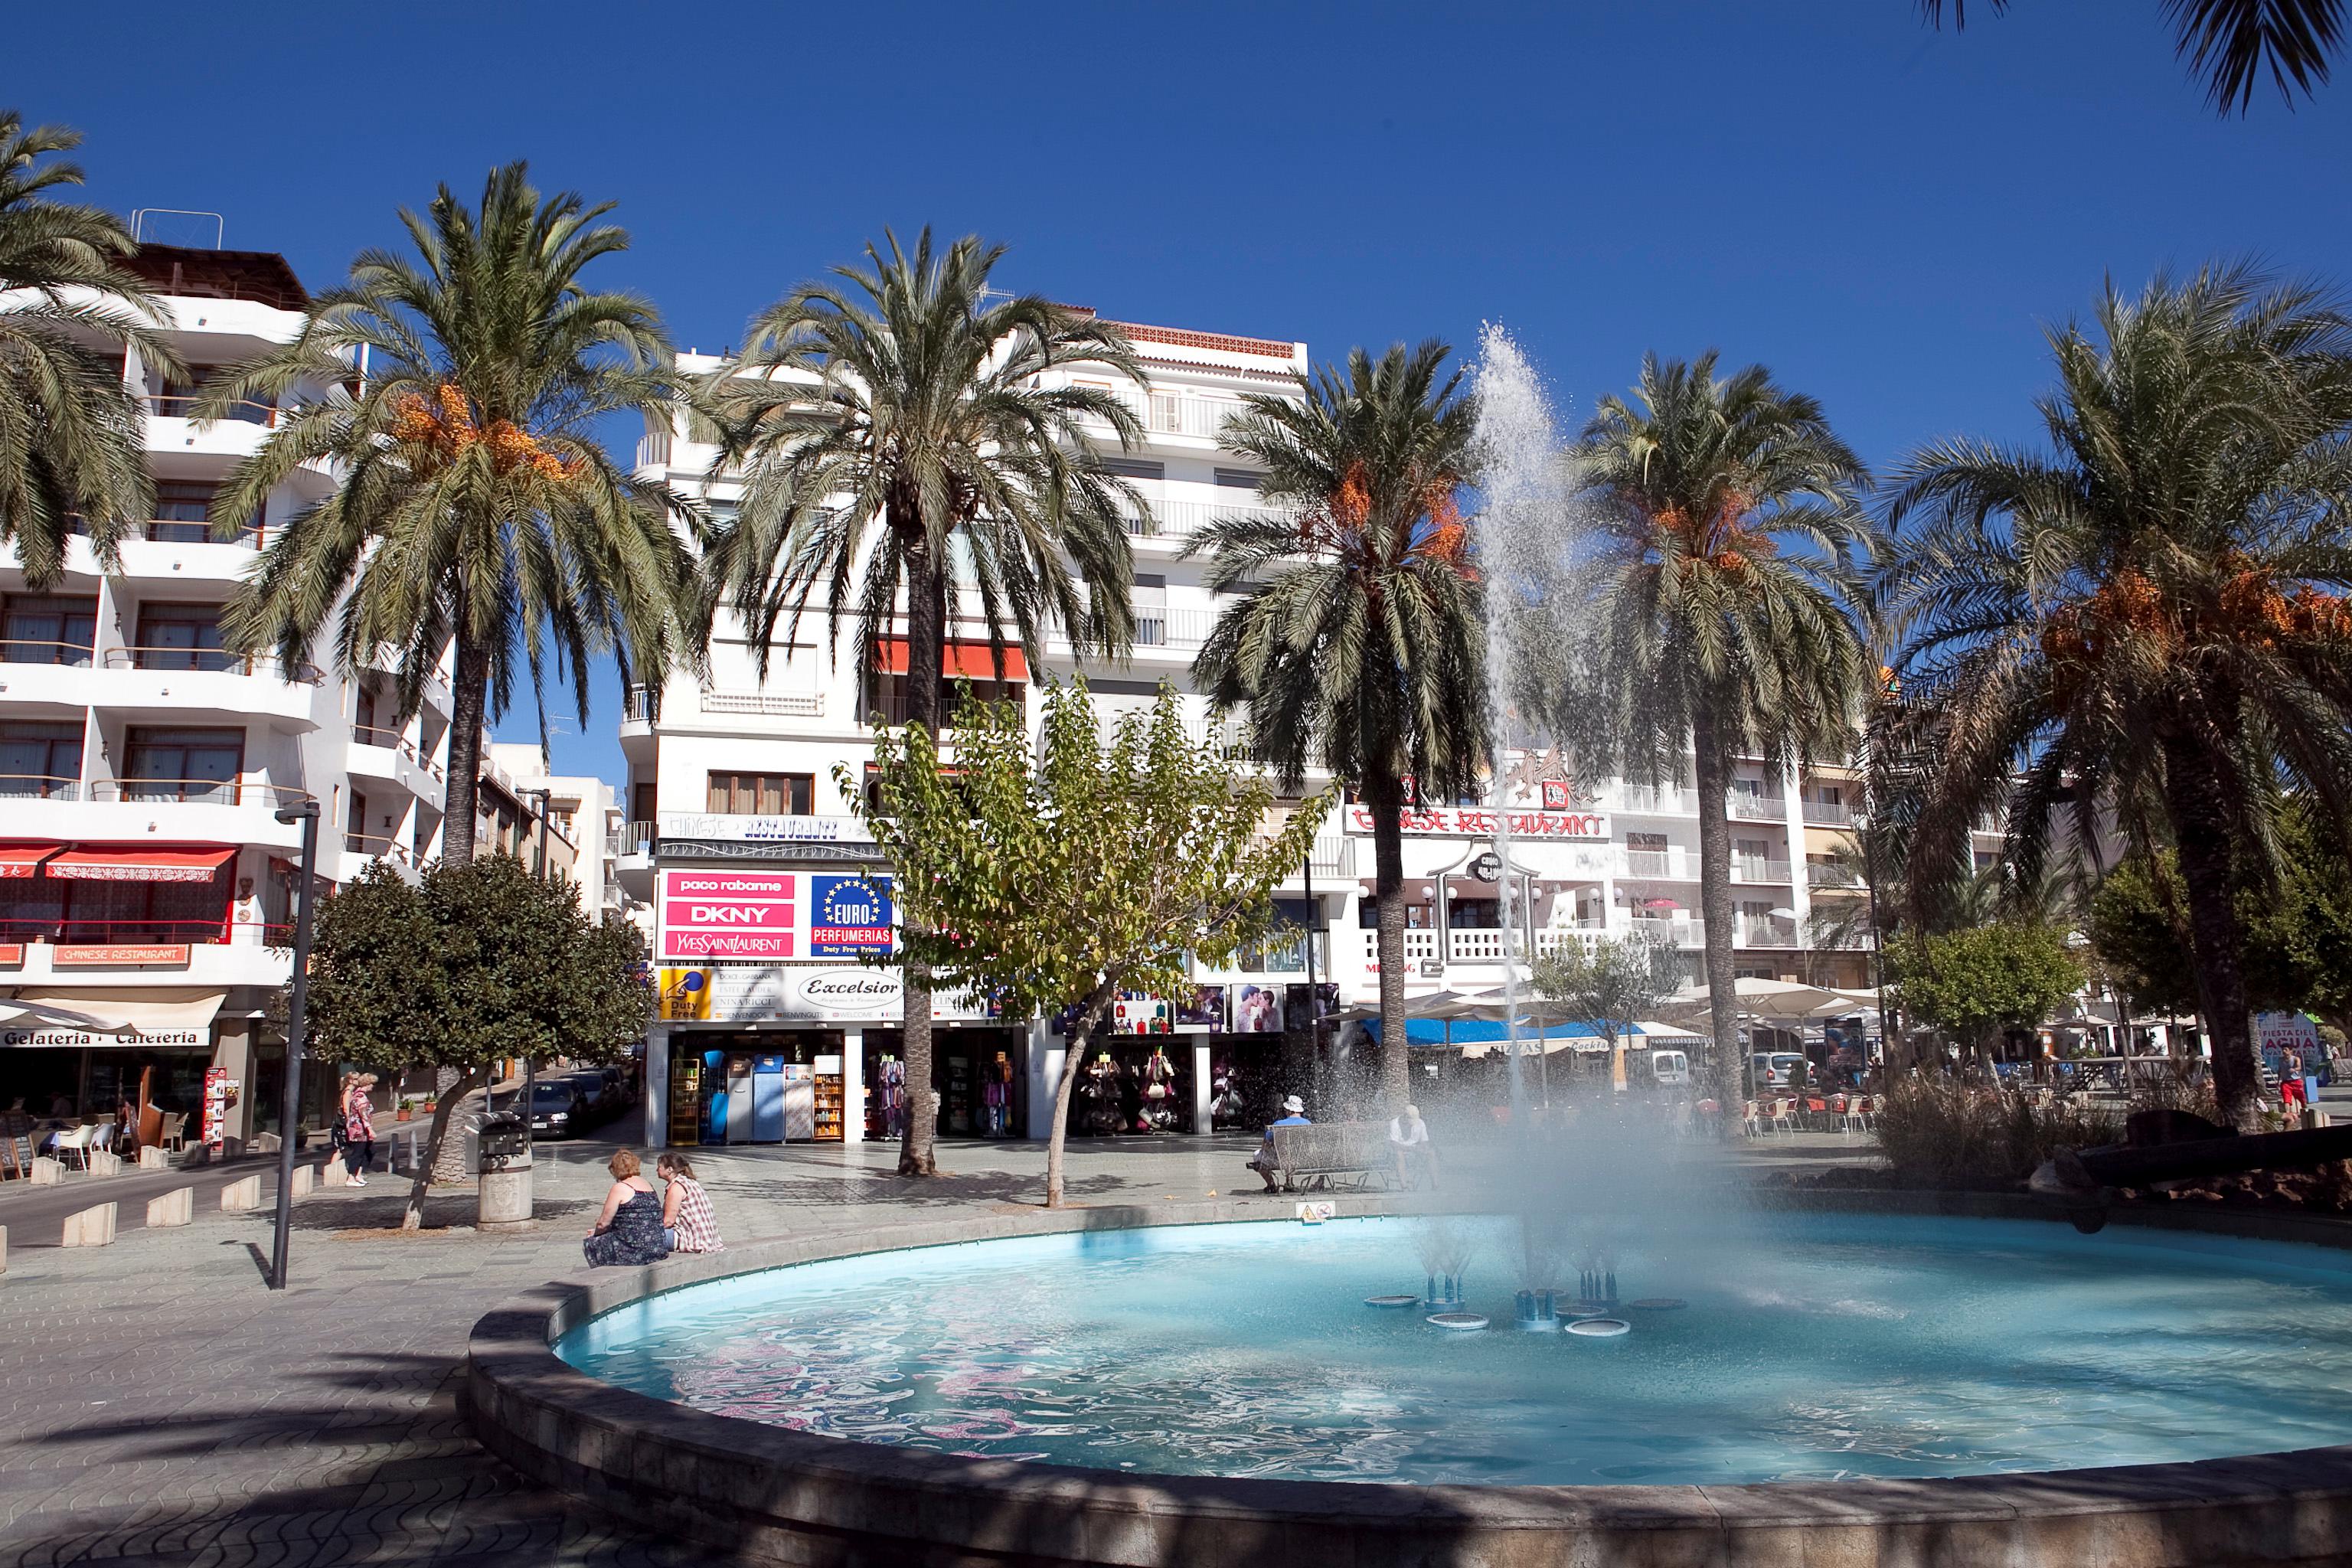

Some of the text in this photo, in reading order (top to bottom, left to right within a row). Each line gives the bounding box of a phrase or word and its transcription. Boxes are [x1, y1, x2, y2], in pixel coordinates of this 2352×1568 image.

[745, 818, 838, 839] RESTAURANTE
[1454, 810, 1605, 835] RESTAURANT
[681, 880, 782, 892] paco rabanne
[691, 906, 770, 923] DKNY
[834, 903, 870, 925] EURO
[813, 929, 890, 943] PERFUMERIAS
[64, 949, 178, 960] CHINESE RESTAURANT
[823, 946, 840, 954] Duty
[807, 979, 898, 994] Excelsior
[671, 1001, 698, 1011] Duty
[671, 1010, 697, 1018] Free
[4, 1032, 90, 1046] Gelateria
